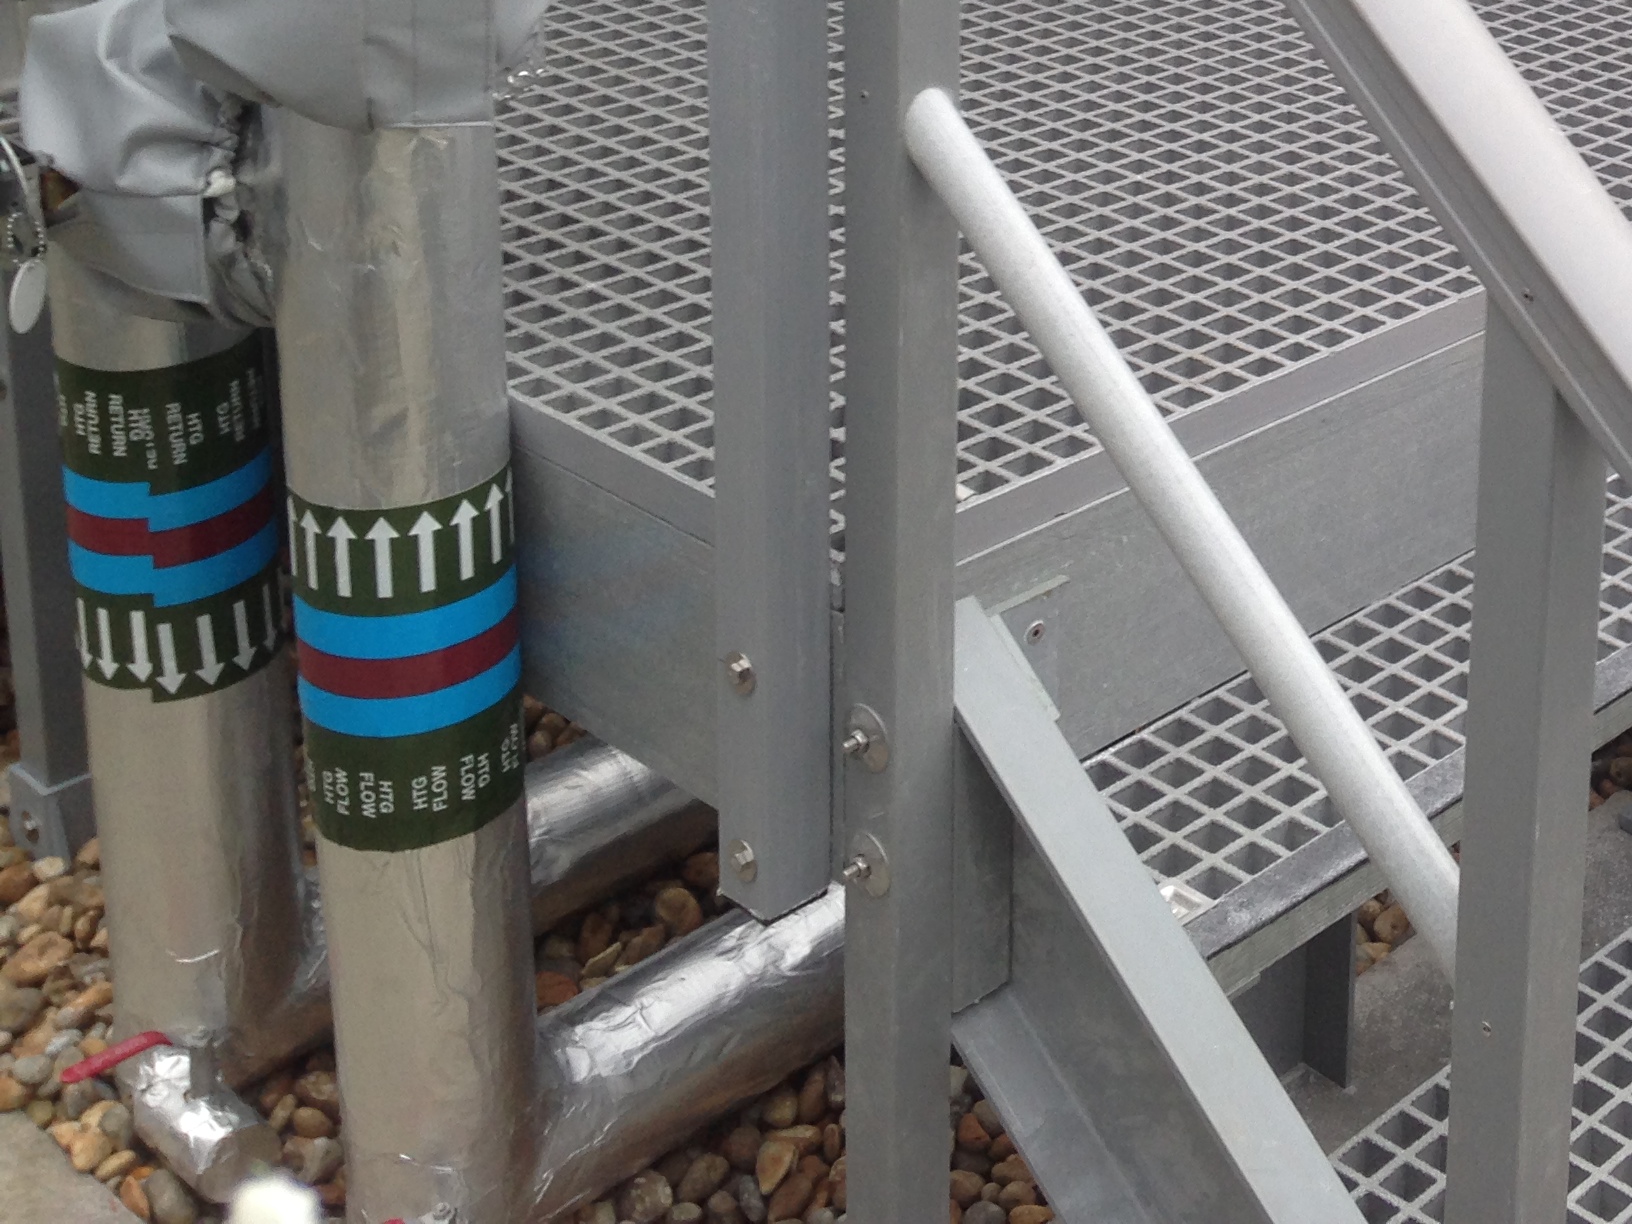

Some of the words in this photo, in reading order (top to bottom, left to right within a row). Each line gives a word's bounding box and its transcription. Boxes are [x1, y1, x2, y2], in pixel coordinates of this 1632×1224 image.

[73, 402, 86, 437] HTG
[84, 390, 101, 455] RETURN
[108, 393, 127, 457] RETURN
[128, 408, 144, 443] HTG
[165, 401, 188, 466] RETURN
[186, 412, 204, 446] HTG
[322, 770, 335, 805] HTG
[430, 765, 448, 812] FLOW
[459, 753, 477, 801] FLOW
[477, 752, 491, 788] HTG
[334, 766, 350, 816] FLOW
[359, 771, 377, 819] FLOW
[378, 780, 395, 814] HTG
[411, 775, 429, 810] HTG
